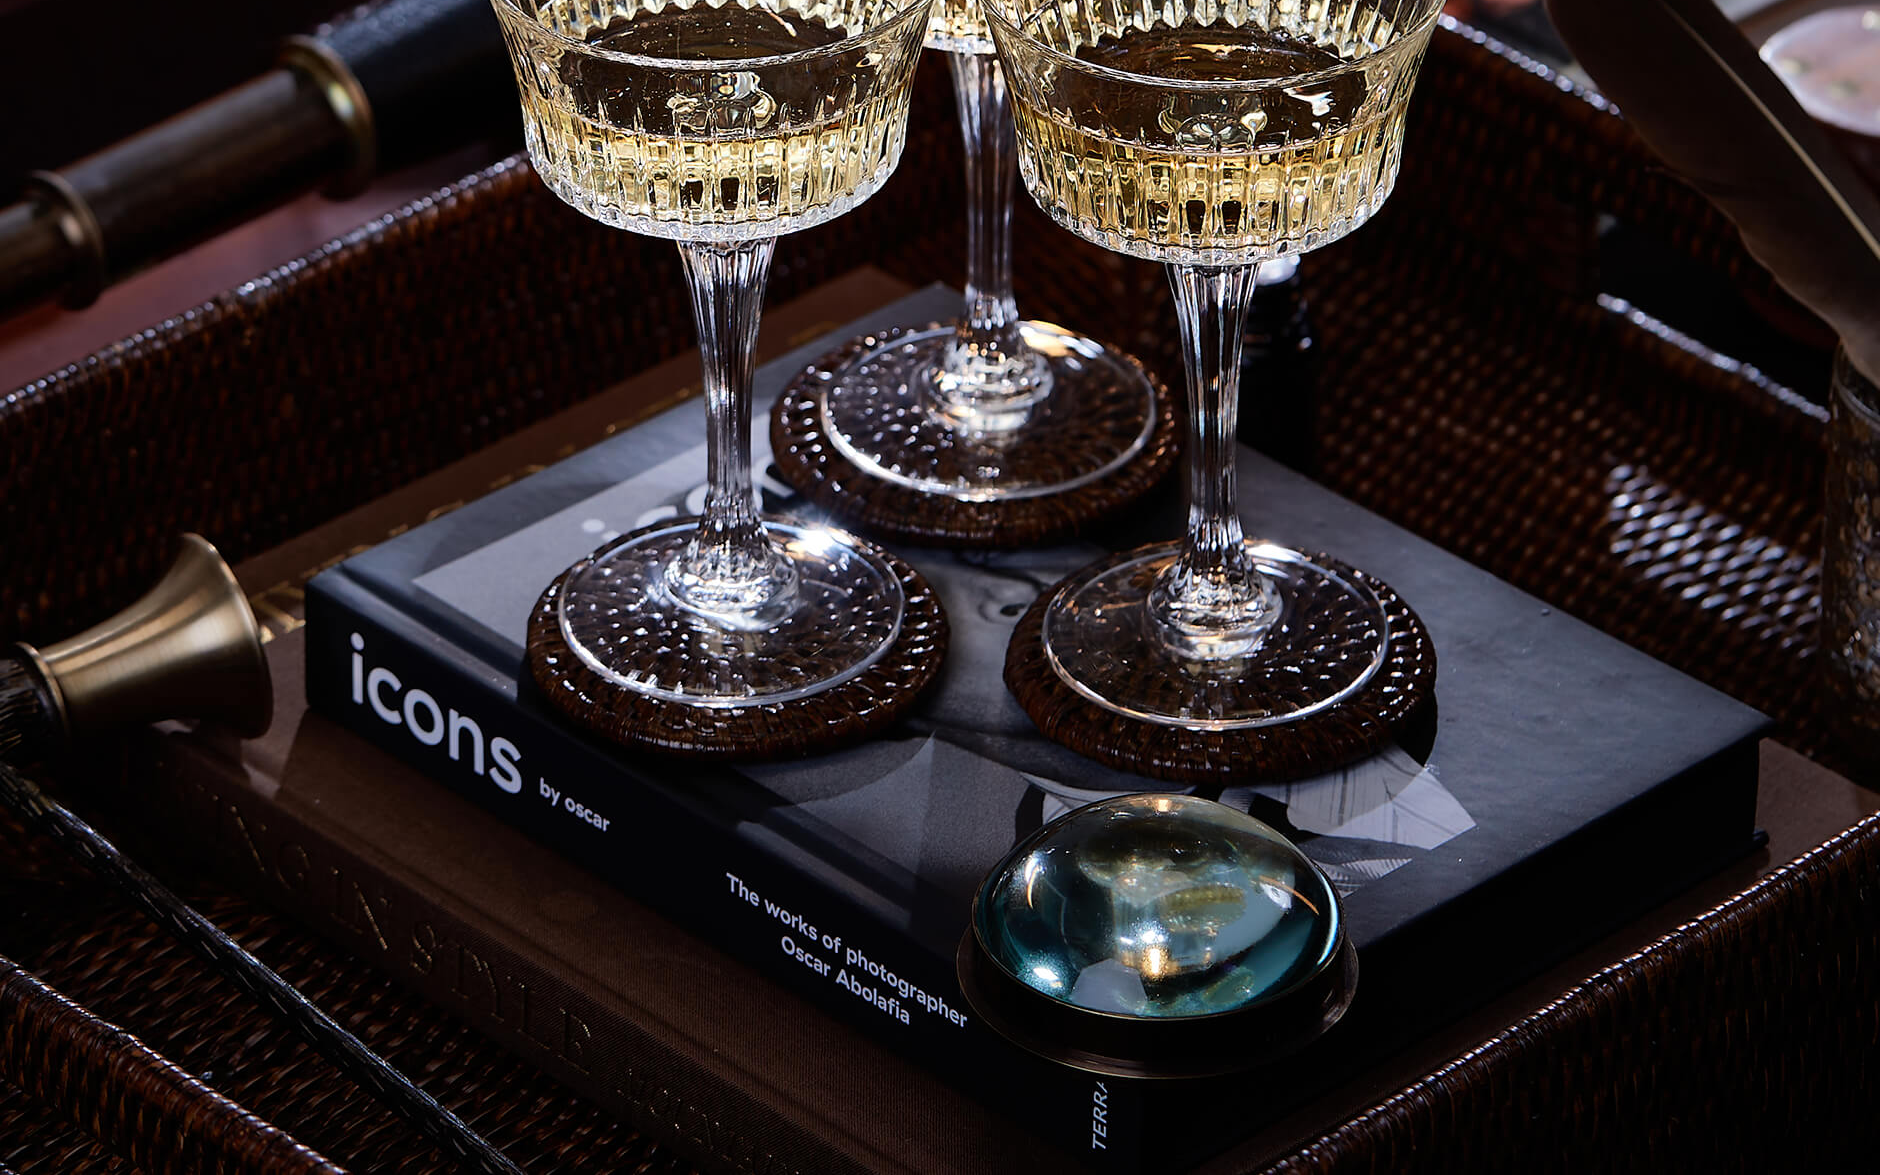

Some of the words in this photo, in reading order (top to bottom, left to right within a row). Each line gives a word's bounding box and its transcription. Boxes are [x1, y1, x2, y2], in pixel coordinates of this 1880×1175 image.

[350, 631, 522, 794] icons
[539, 776, 561, 807] by
[564, 796, 611, 832] oscar
[726, 871, 760, 907] The
[764, 898, 818, 941] works
[822, 936, 842, 954] of
[846, 947, 967, 1028] photographer
[781, 935, 831, 976] Oscar
[835, 969, 910, 1026] Abolafia
